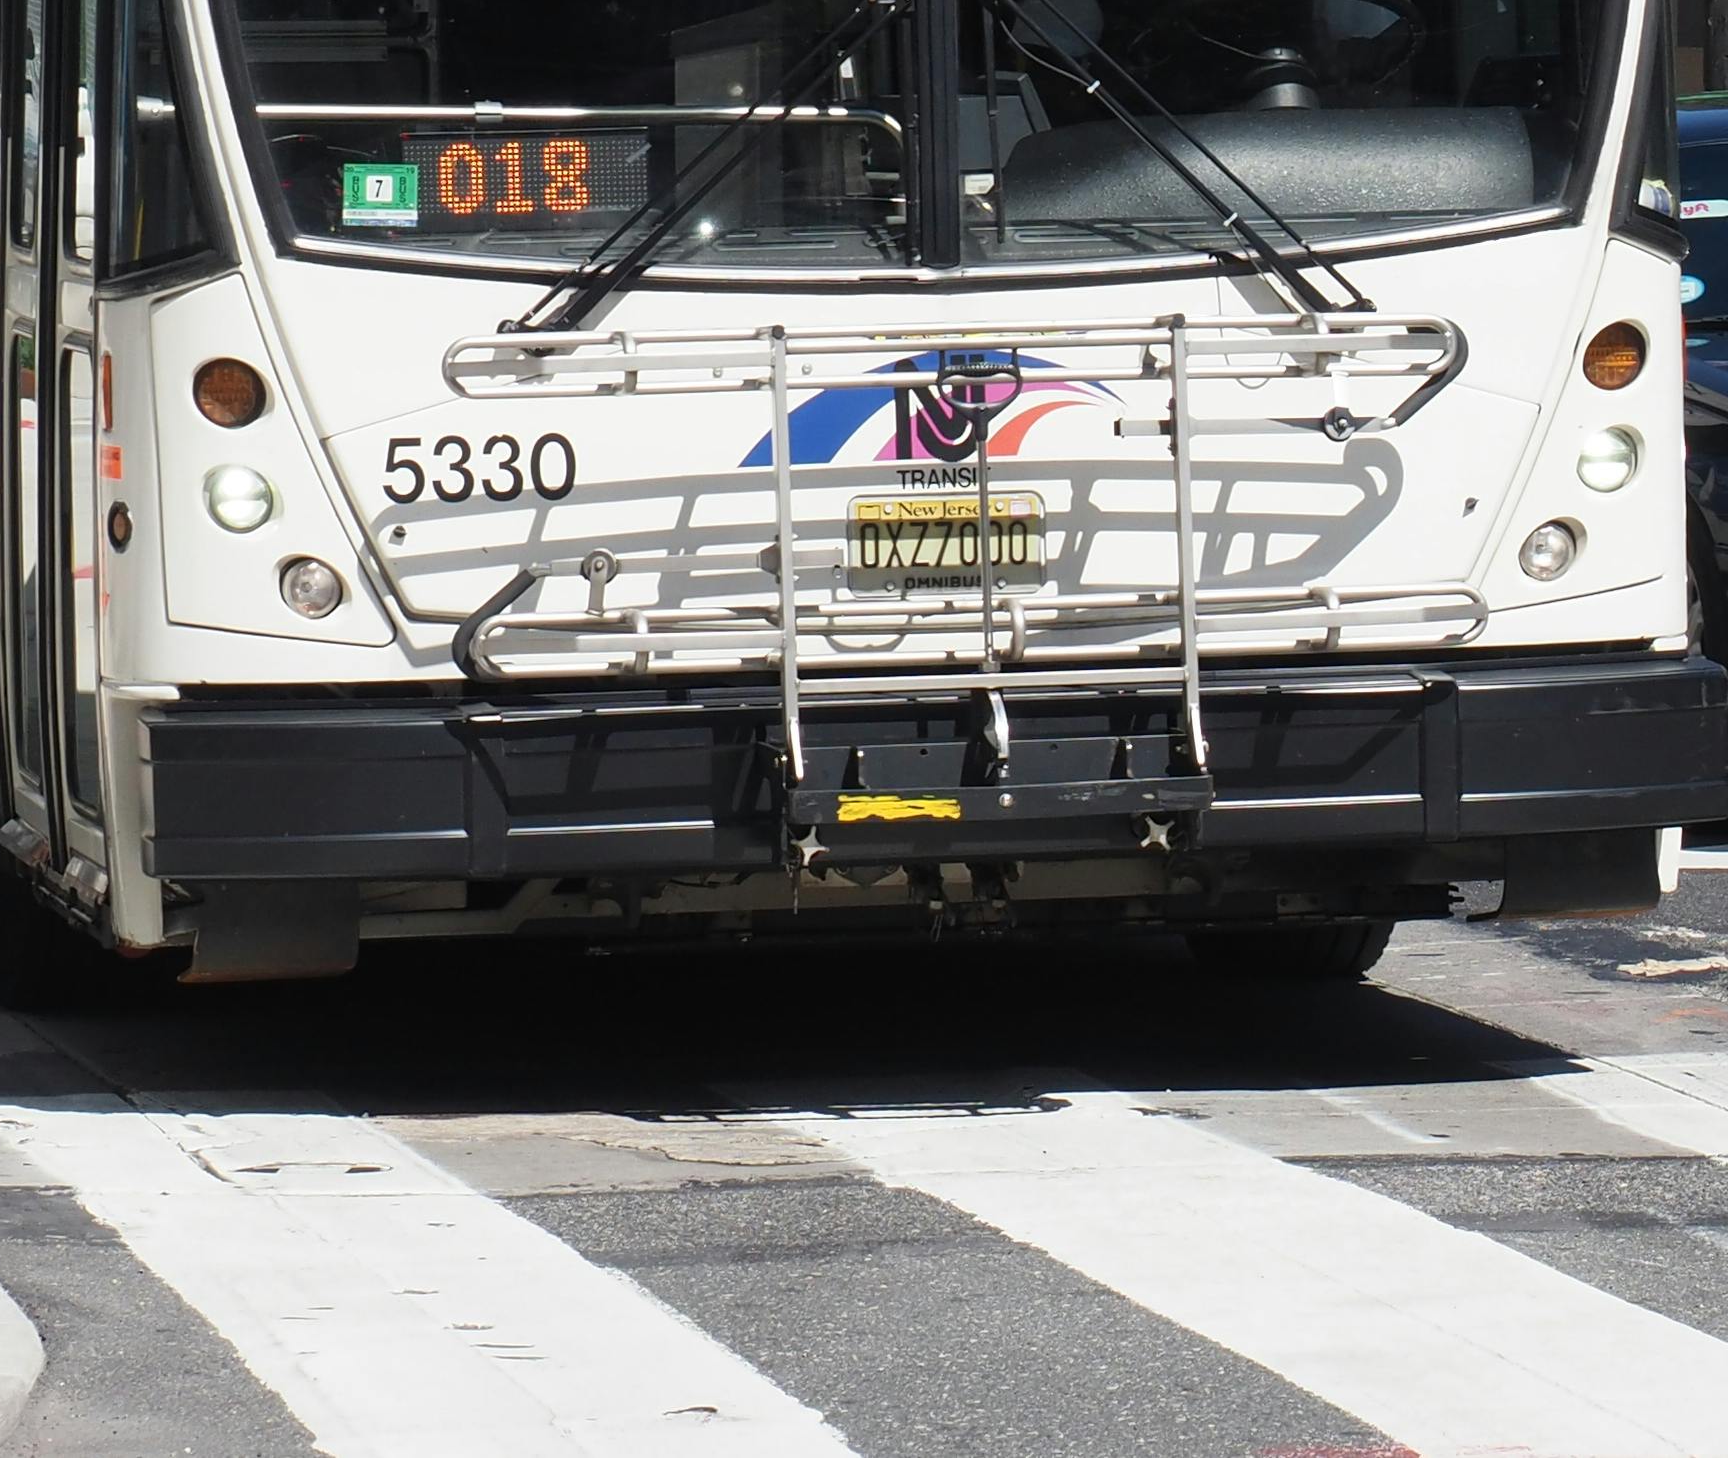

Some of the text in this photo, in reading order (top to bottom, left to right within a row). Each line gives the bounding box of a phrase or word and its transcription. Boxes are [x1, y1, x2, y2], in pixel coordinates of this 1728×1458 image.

[439, 140, 588, 214] 018
[375, 179, 384, 199] 7
[1680, 203, 1709, 216] yft
[382, 432, 576, 504] 5330
[896, 466, 992, 489] TRANSI
[898, 501, 992, 519] New Jerse
